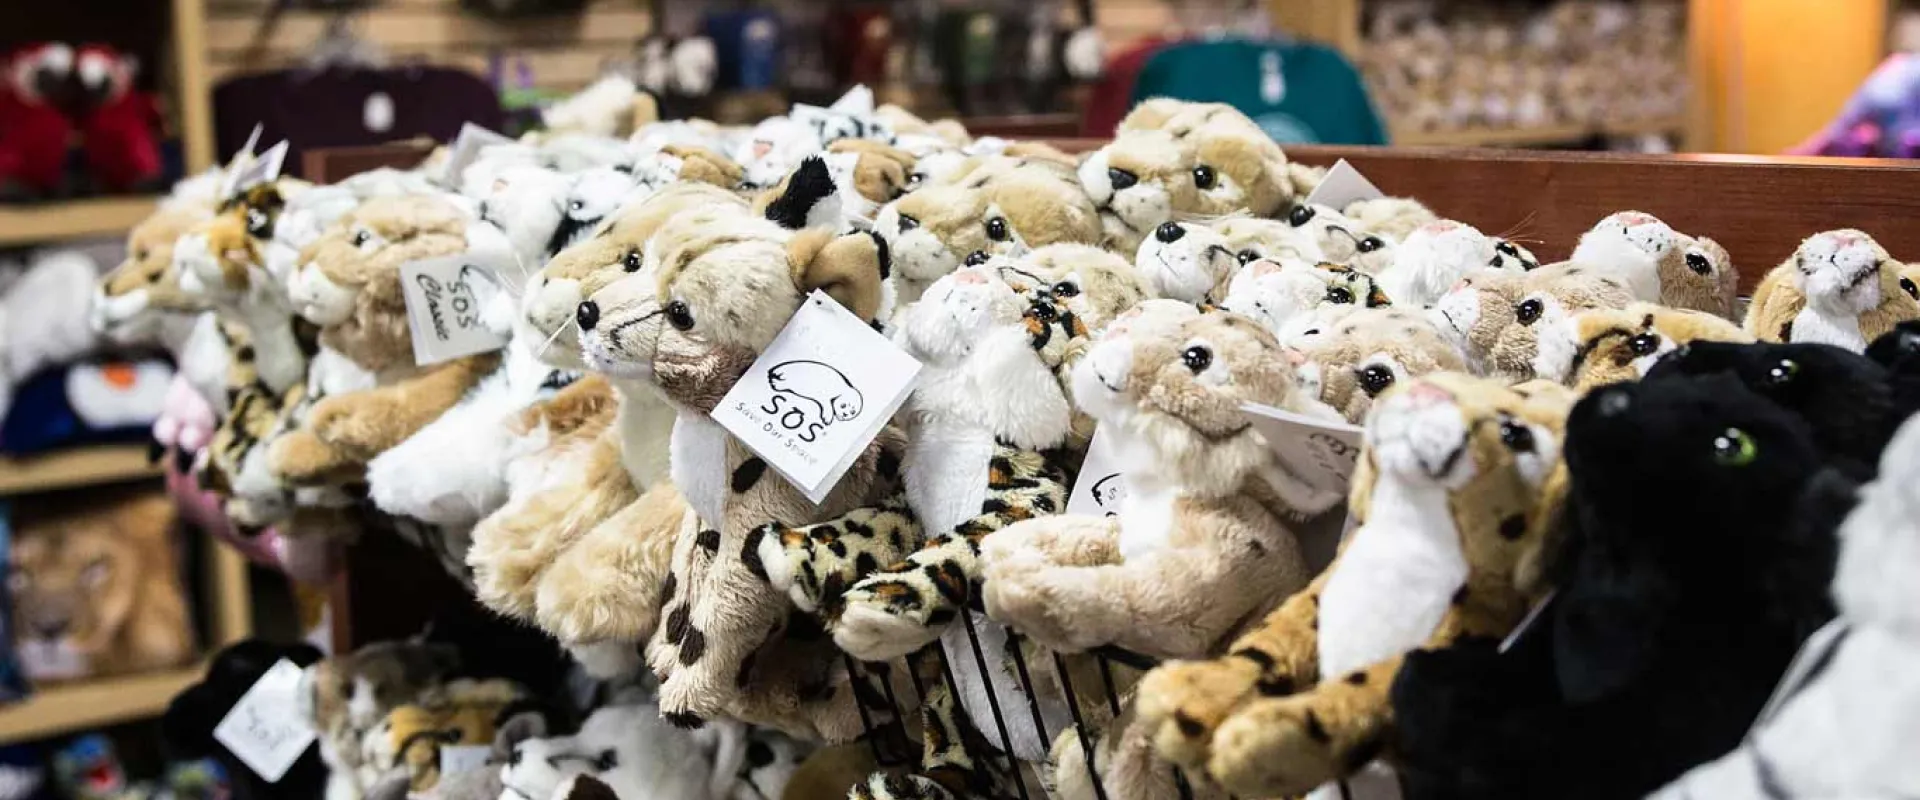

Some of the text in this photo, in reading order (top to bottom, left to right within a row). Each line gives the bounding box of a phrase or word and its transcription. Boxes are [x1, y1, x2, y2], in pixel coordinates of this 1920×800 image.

[446, 281, 472, 328] SOS
[761, 395, 824, 442] SOS
[762, 422, 784, 439] Our
